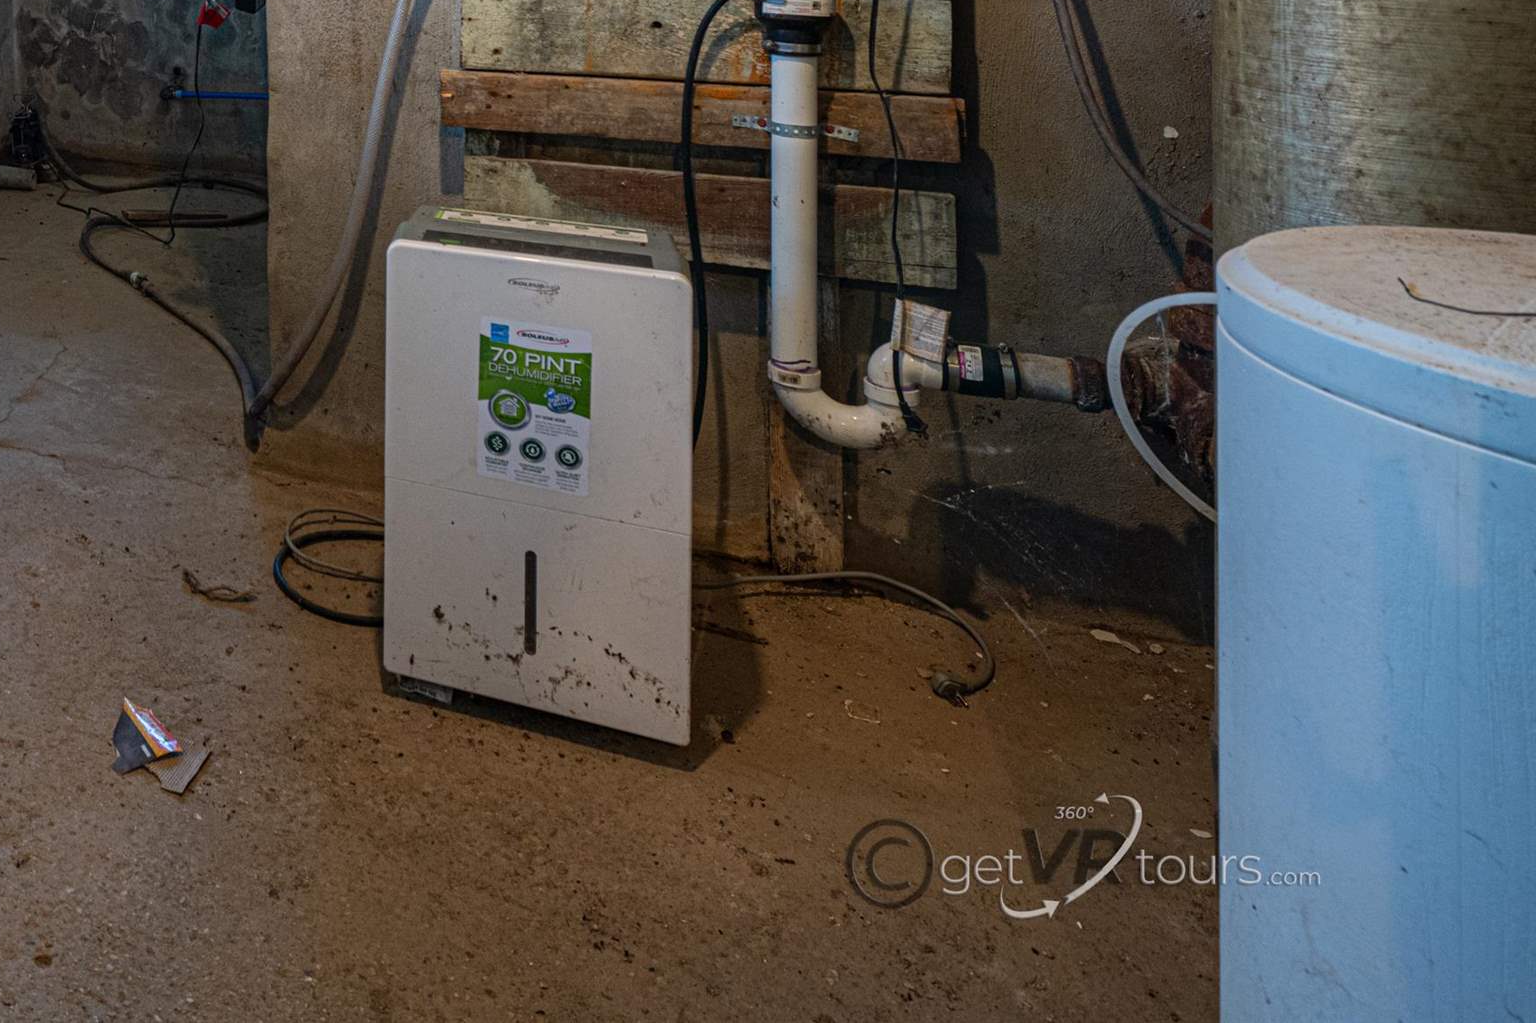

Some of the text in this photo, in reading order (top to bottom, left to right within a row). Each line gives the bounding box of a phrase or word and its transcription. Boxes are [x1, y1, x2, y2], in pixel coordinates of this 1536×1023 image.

[490, 346, 582, 375] 70 PINT
[488, 362, 583, 386] DEHUMIDIFIER
